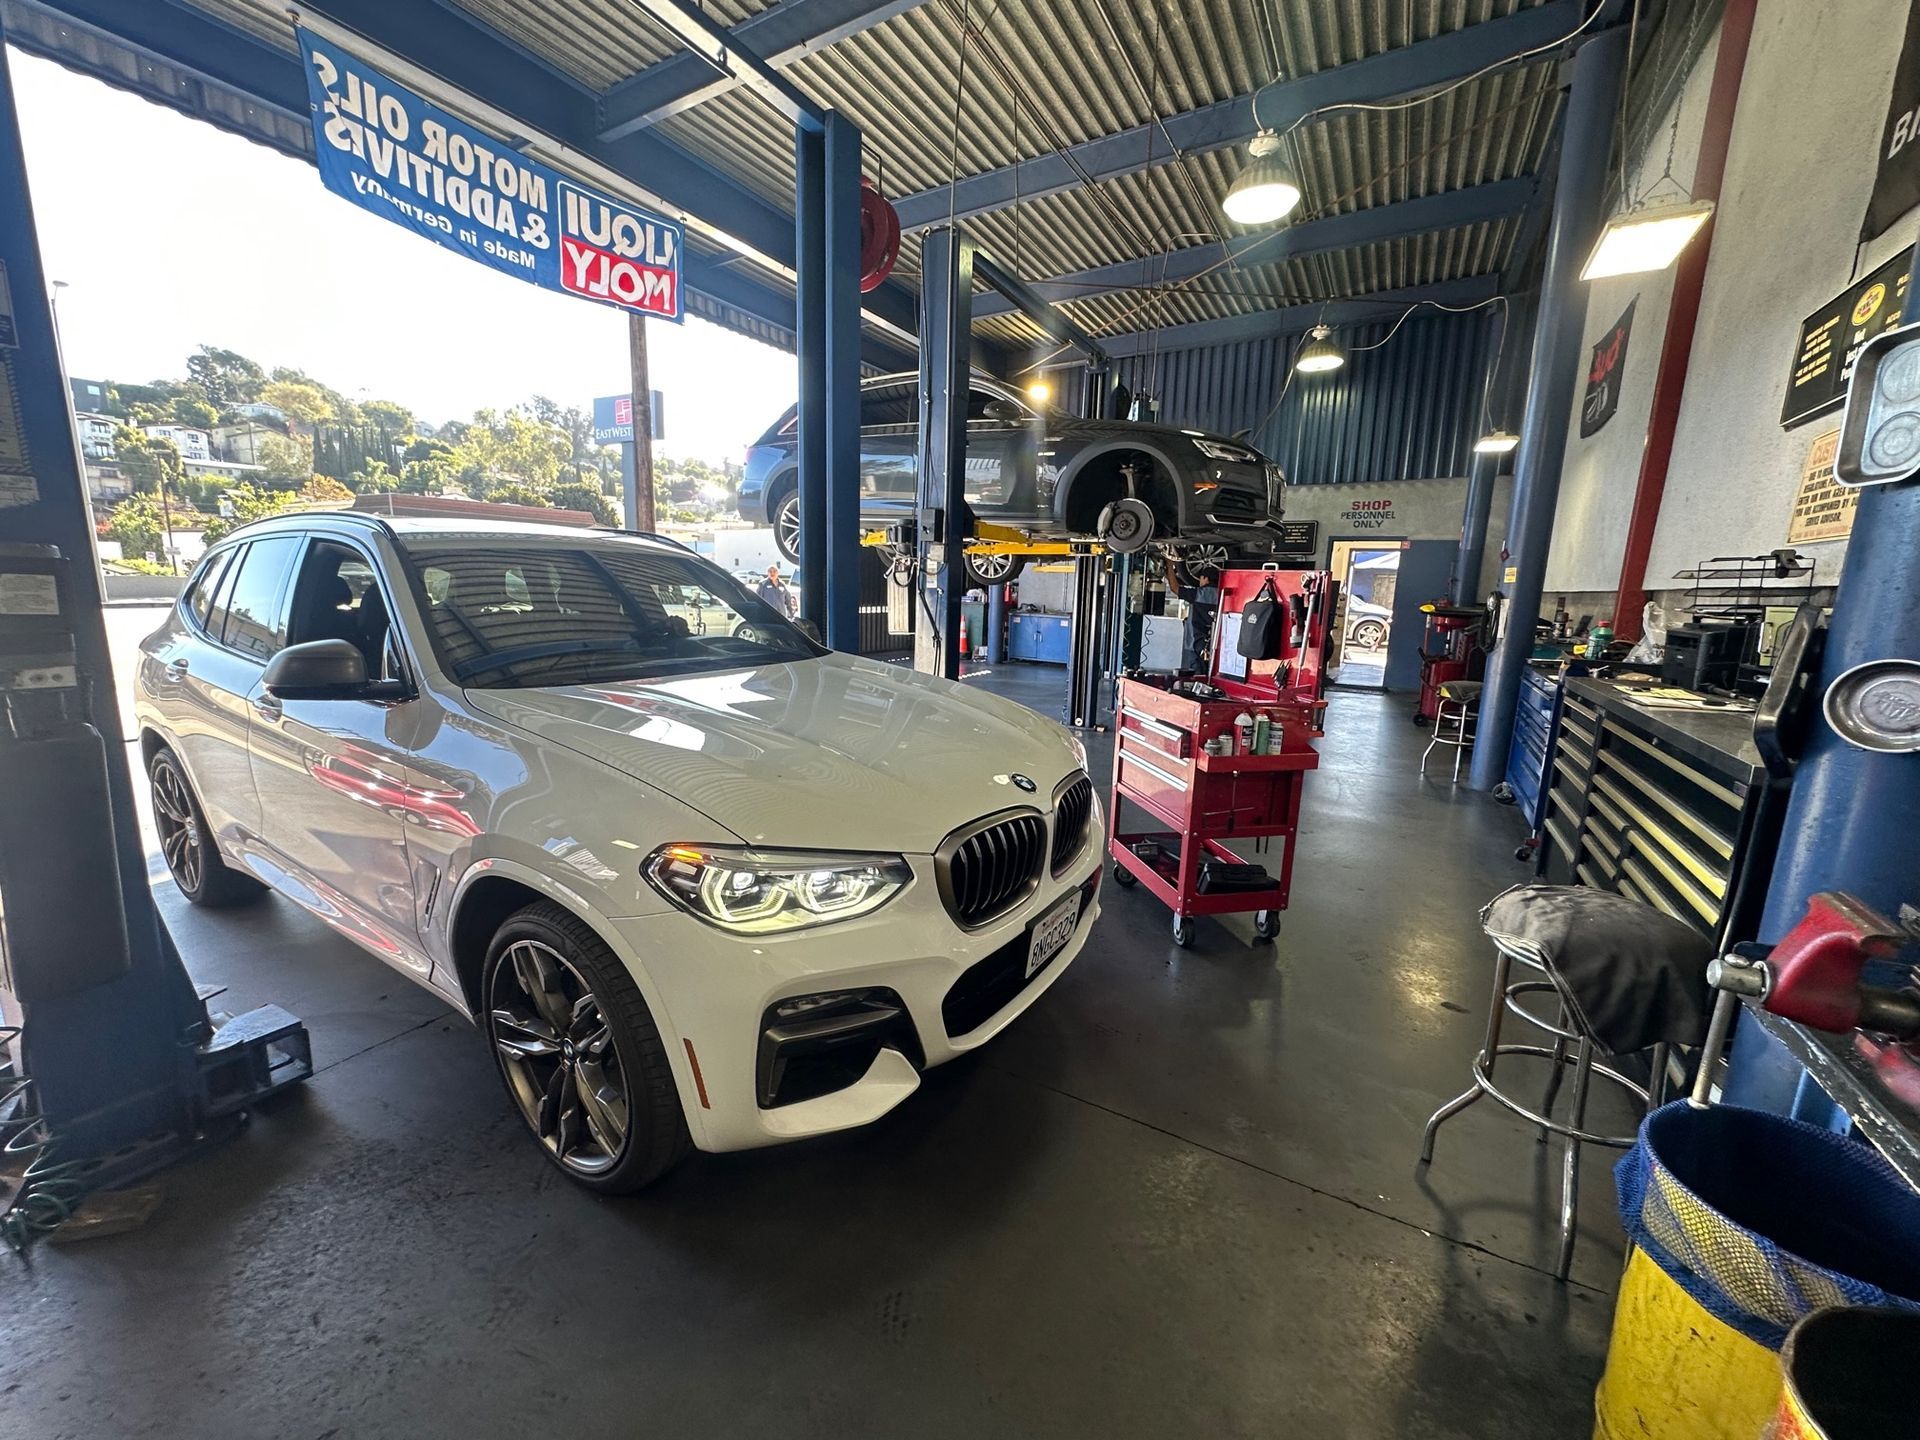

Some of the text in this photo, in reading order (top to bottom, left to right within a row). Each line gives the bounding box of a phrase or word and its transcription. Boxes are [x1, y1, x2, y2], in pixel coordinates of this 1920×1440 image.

[1351, 500, 1392, 511] SHOP
[1341, 511, 1396, 520] PERSONNEL
[1353, 520, 1383, 528] ONLY
